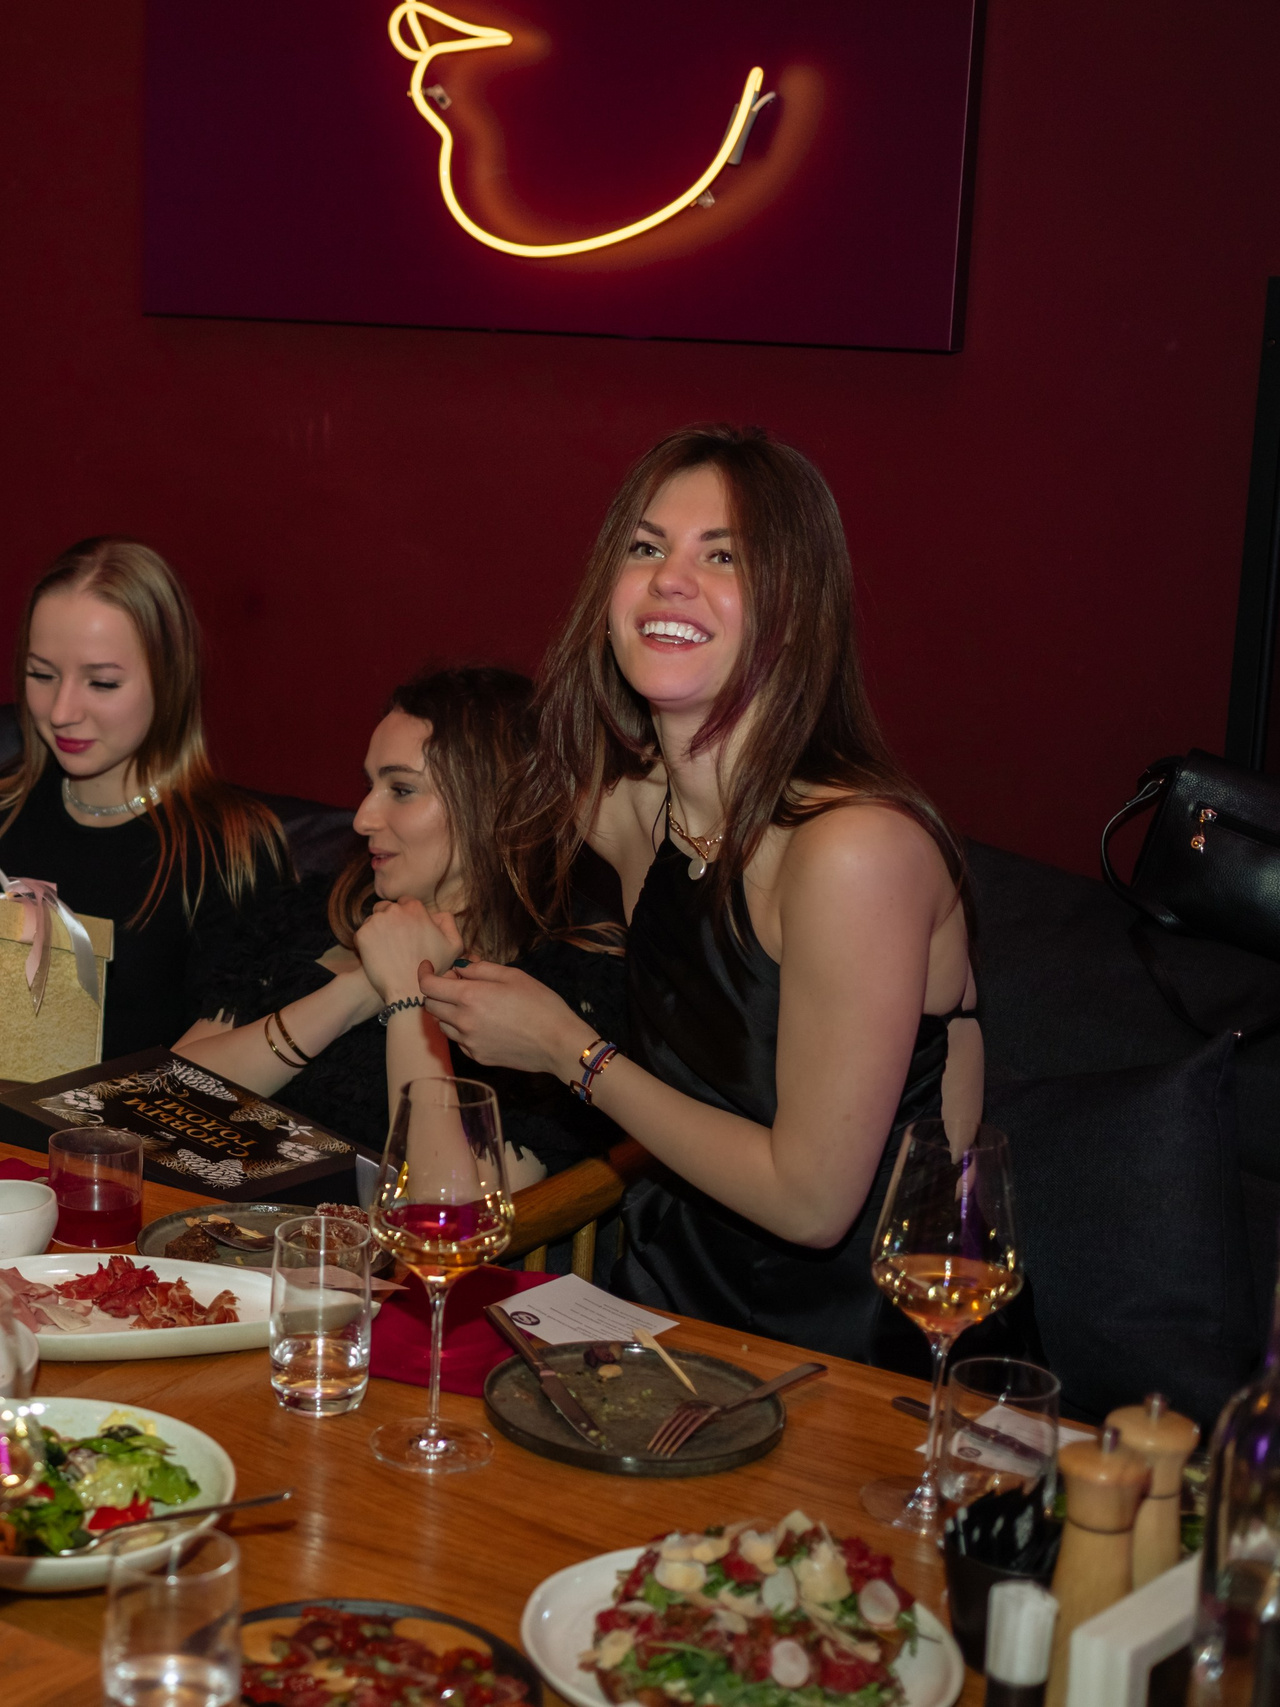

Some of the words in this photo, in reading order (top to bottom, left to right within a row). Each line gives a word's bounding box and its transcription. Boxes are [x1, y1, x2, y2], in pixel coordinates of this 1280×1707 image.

[122, 1097, 231, 1149] НОВЫМ
[154, 1098, 259, 1148] ГОДОМ!
[227, 1147, 249, 1157] С
